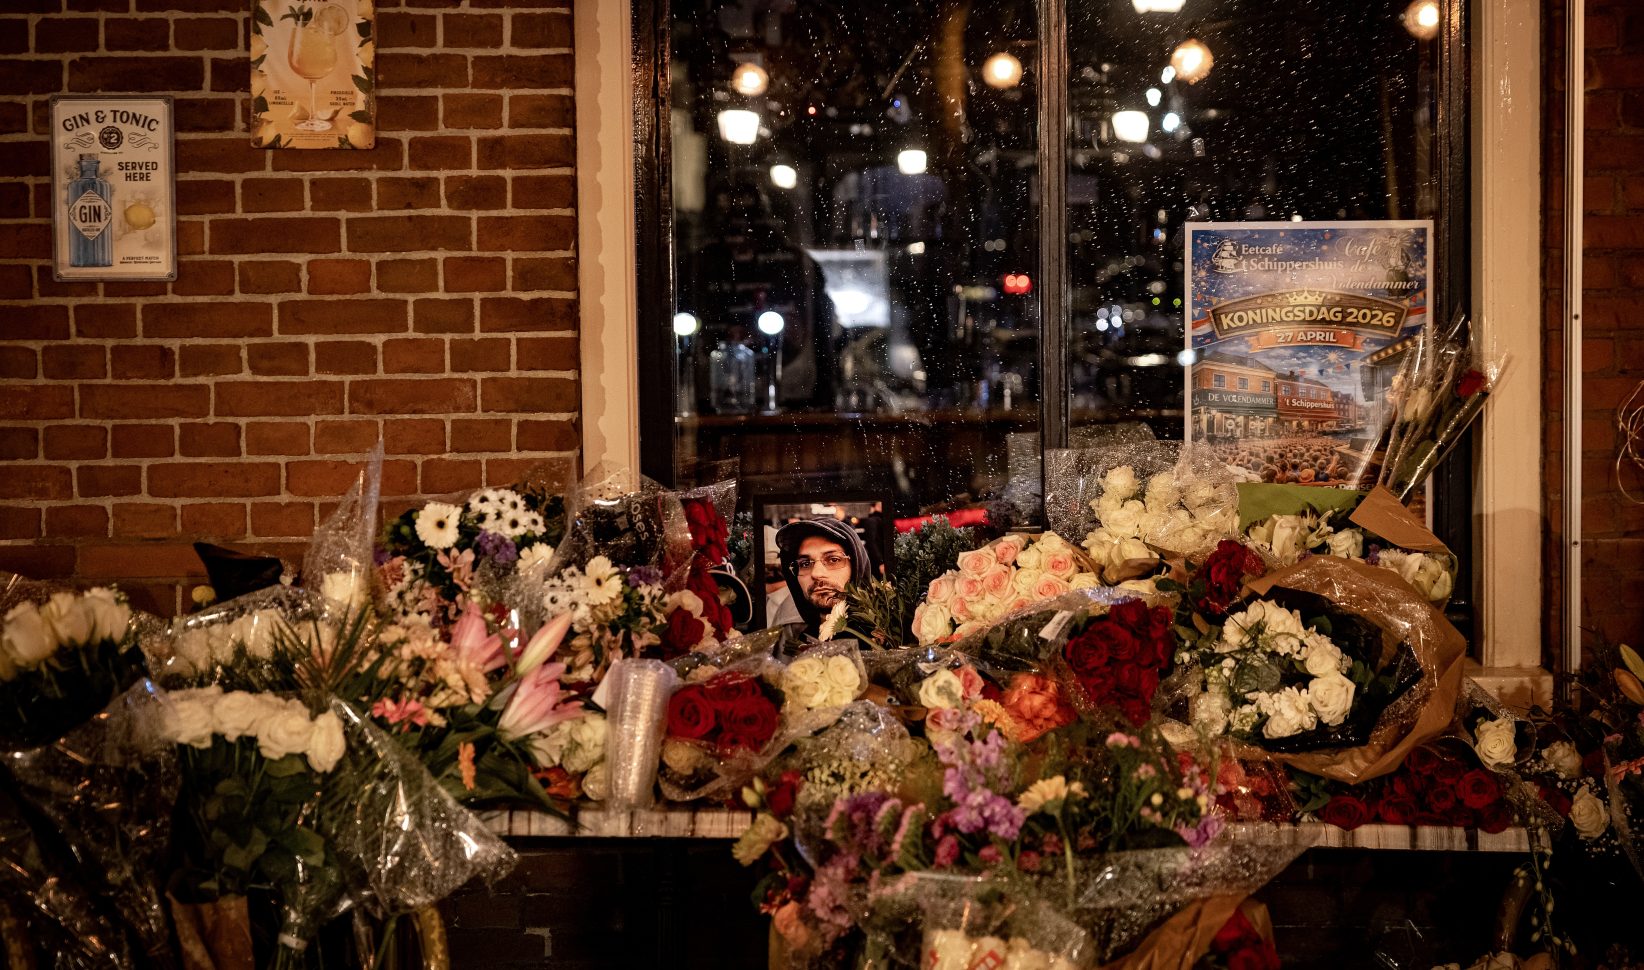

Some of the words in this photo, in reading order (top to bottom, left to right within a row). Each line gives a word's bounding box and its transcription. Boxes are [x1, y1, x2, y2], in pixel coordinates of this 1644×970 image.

[62, 112, 91, 132] GIN
[94, 110, 107, 124] &
[110, 109, 159, 132] TONIC
[117, 161, 158, 171] SERVED
[125, 172, 152, 182] HERE
[79, 205, 102, 224] GIN
[1241, 243, 1284, 255] Eetcafé
[1249, 256, 1344, 275] Schippershuis
[1350, 259, 1367, 273] de
[1220, 306, 1343, 330] KONINGSDAG
[1346, 307, 1396, 327] 2026
[1276, 332, 1294, 343] 27
[1297, 331, 1337, 342] APRIL
[1208, 393, 1219, 402] DE
[1223, 394, 1275, 405] VOLENDAMMER
[1291, 398, 1335, 409] Schippershuis
[631, 497, 650, 541] oses
